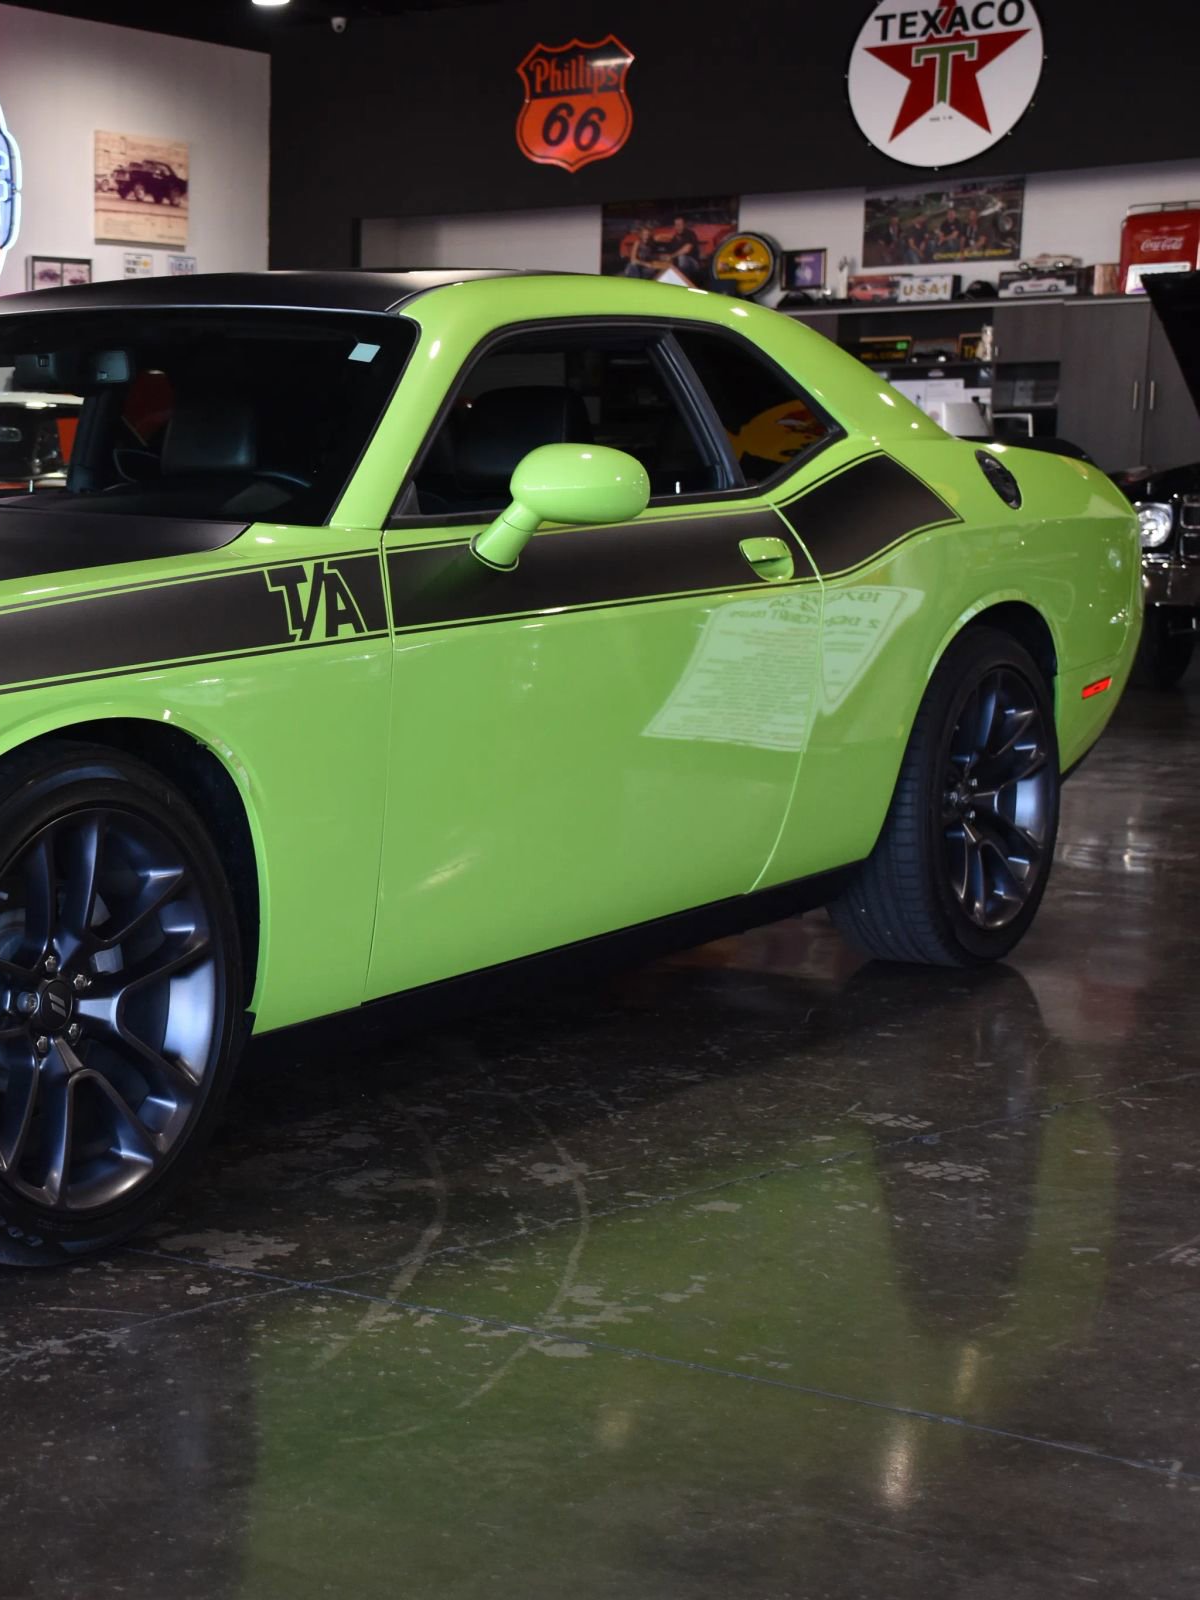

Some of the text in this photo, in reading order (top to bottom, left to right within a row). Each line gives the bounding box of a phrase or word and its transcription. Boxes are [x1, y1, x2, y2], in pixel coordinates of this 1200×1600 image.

[874, 0, 1026, 42] TEXACO
[529, 55, 619, 97] Phillips
[542, 102, 607, 152] 66
[264, 560, 367, 642] T/A
